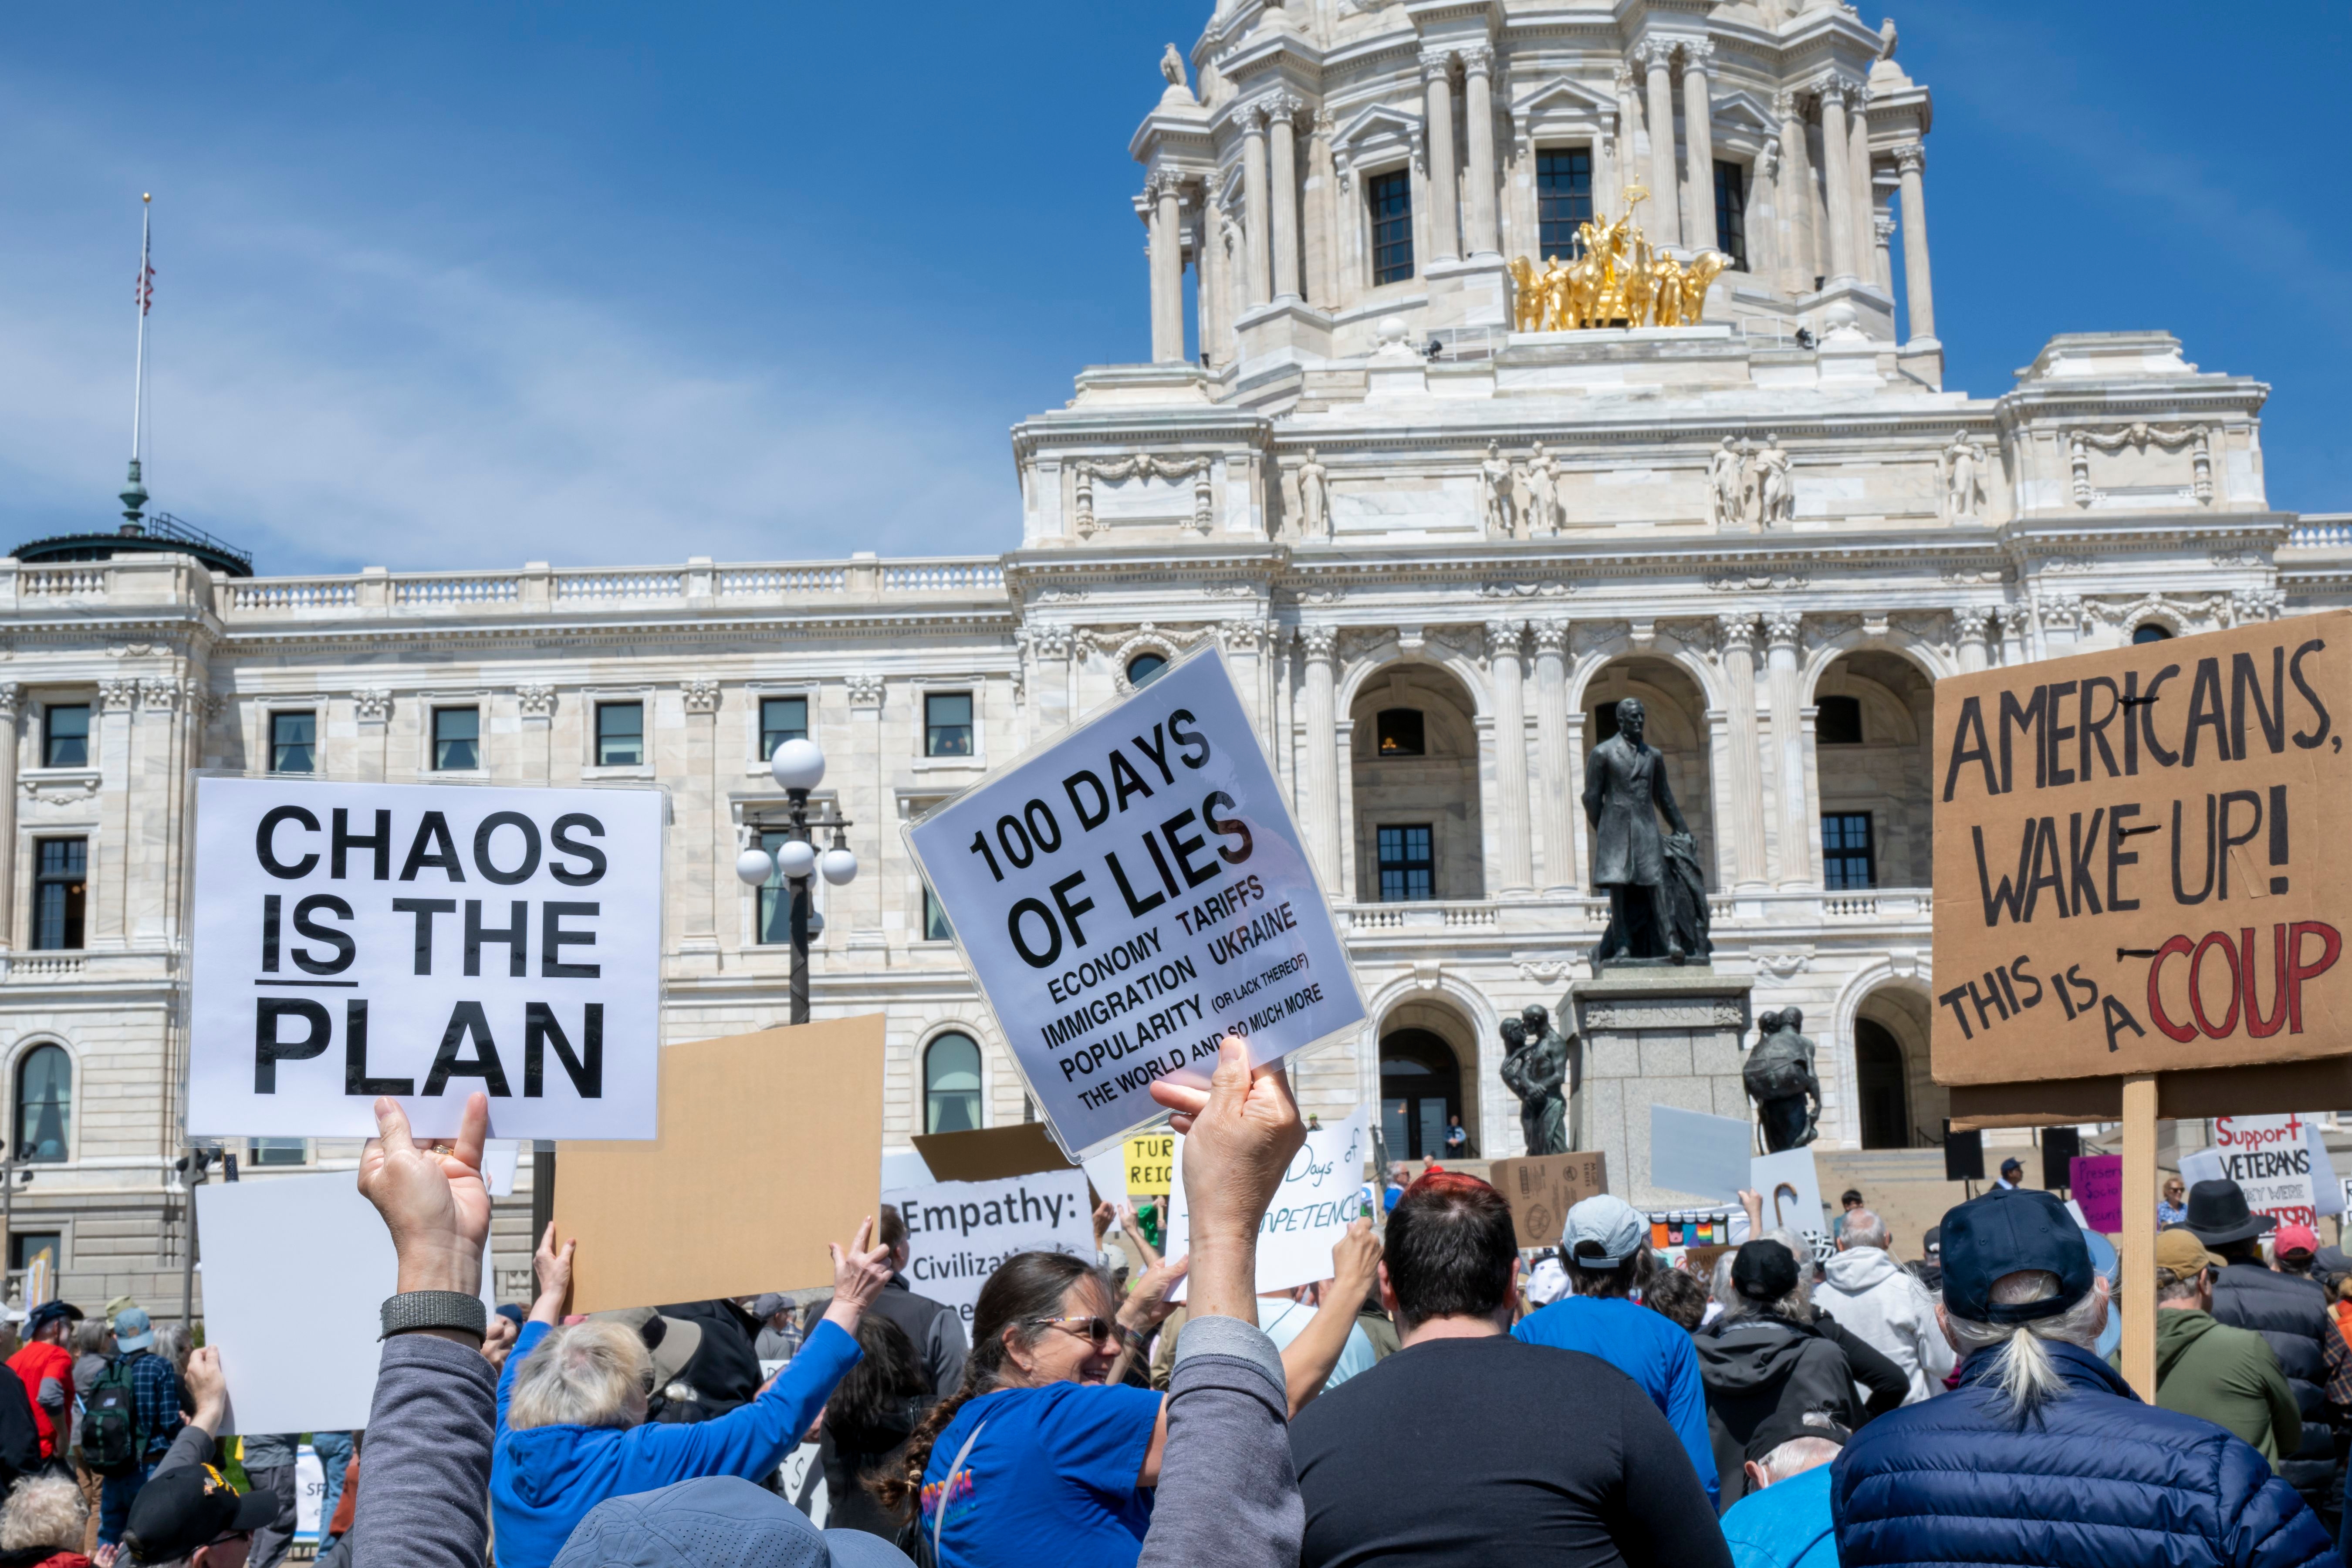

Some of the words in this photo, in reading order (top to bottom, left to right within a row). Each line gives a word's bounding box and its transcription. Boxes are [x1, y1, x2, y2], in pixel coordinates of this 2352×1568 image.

[1943, 639, 2342, 801] AMERICANS,
[255, 805, 607, 886] CHAOS
[970, 798, 1061, 882] 100
[1062, 709, 1210, 833] DAYS
[1008, 870, 1095, 969] OF
[1104, 791, 1253, 919] LIES
[1972, 803, 2140, 927] WAKE
[2171, 785, 2289, 906] UP!
[262, 894, 356, 976] IS
[392, 898, 601, 978] THE
[1041, 955, 1197, 1049] IMMIGRATION
[1207, 902, 1297, 965] UKRAINE
[1047, 927, 1163, 1005] ECONOMY
[1175, 874, 1264, 936] TARIFFS
[1939, 955, 2043, 1040] THIS
[2051, 963, 2099, 1021] IS
[2101, 995, 2146, 1052] A
[2147, 921, 2342, 1043] COUP
[254, 997, 604, 1098] PLAN
[1059, 994, 1203, 1082] POPULARITY
[1211, 992, 1234, 1014] (OR
[1233, 977, 1262, 1000] LACK
[1260, 953, 1309, 987] THEREOF)
[1077, 1081, 1119, 1110] THE
[1115, 1048, 1186, 1094] WORLD
[1191, 1033, 1225, 1062] AND
[1228, 1021, 1249, 1039] SO
[1248, 1002, 1285, 1033] MUCH
[1284, 983, 1324, 1015] MORE
[1131, 1166, 1173, 1183] REIC
[1134, 1139, 1173, 1158] TUR
[1286, 1143, 1334, 1187] Days
[1345, 1127, 1360, 1163] of
[2216, 1113, 2303, 1151] Support
[902, 1187, 1076, 1237] Empathy:
[1260, 1191, 1359, 1233] MPETENCE
[2268, 1184, 2305, 1200] WERE
